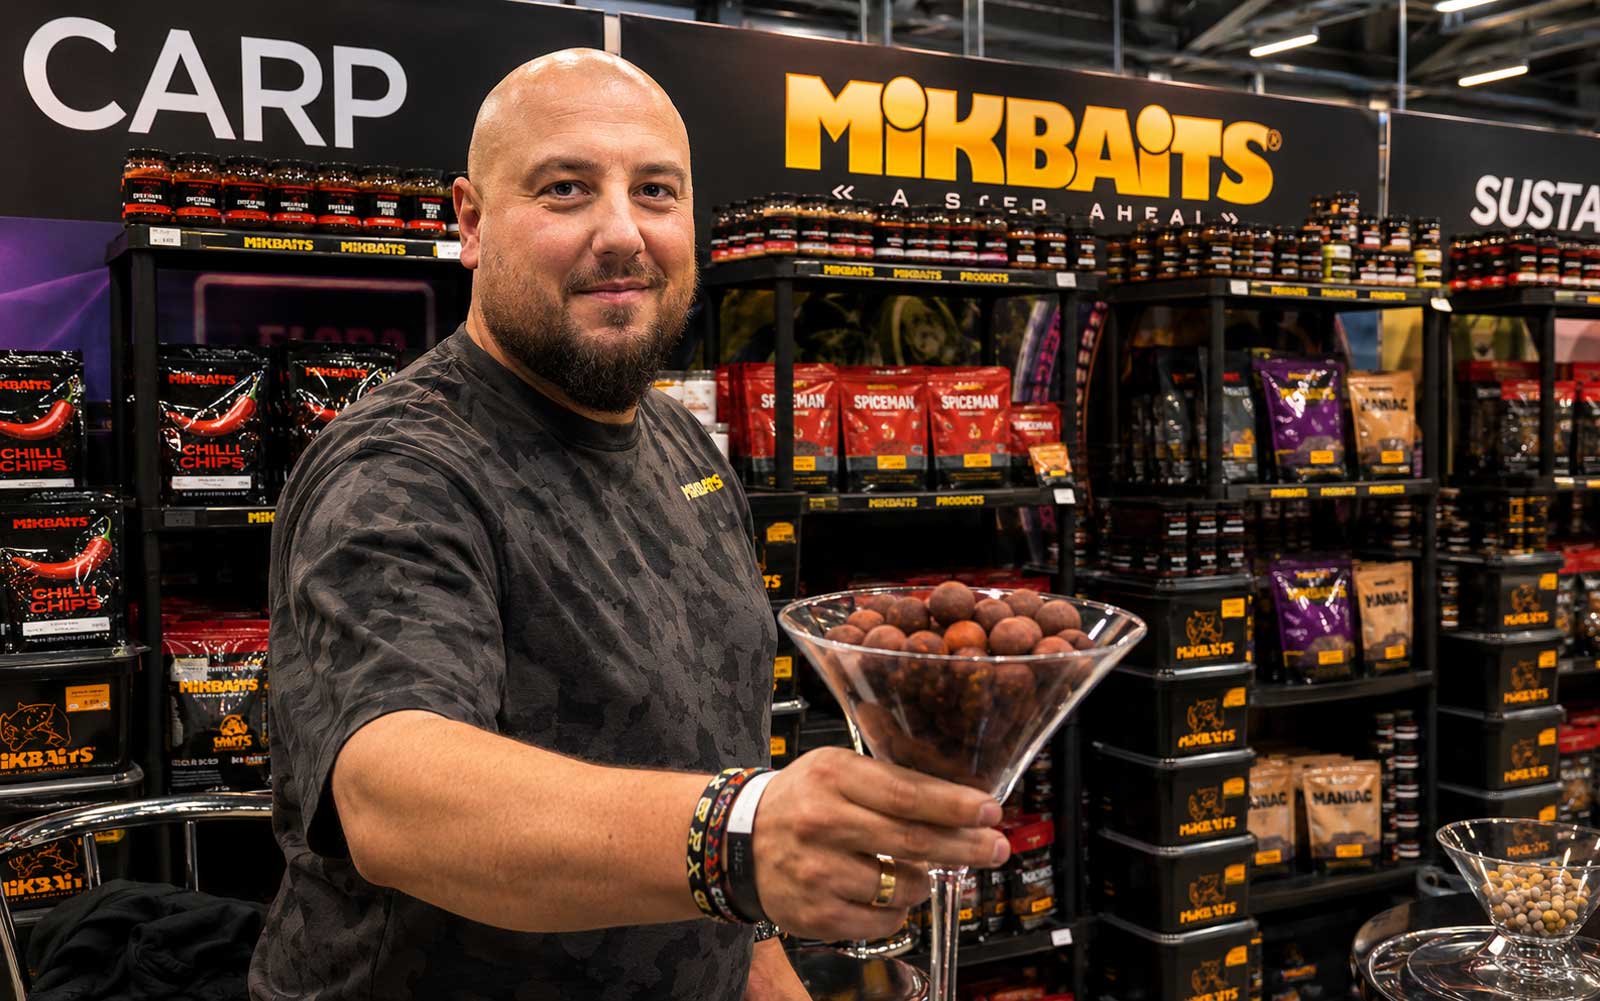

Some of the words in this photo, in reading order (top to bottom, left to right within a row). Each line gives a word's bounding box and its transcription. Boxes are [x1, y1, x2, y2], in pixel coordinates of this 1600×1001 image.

[22, 16, 408, 150] CARP
[891, 188, 909, 208] A
[959, 271, 1010, 284] PRODUCTS
[854, 395, 915, 409] SPICEMAN
[941, 395, 999, 409] SPICEMAN
[0, 447, 62, 460] CHILLI
[182, 443, 241, 456] CHILLI
[0, 459, 67, 472] CHIPS
[179, 456, 245, 469] CHIPS
[935, 495, 985, 506] PRODUCTS
[32, 585, 97, 600] CHILLI
[30, 598, 101, 613] CHIPS
[0, 746, 94, 770] iKBAiTS
[1249, 791, 1288, 809] ANIAC
[1312, 789, 1373, 805] MANIAC
